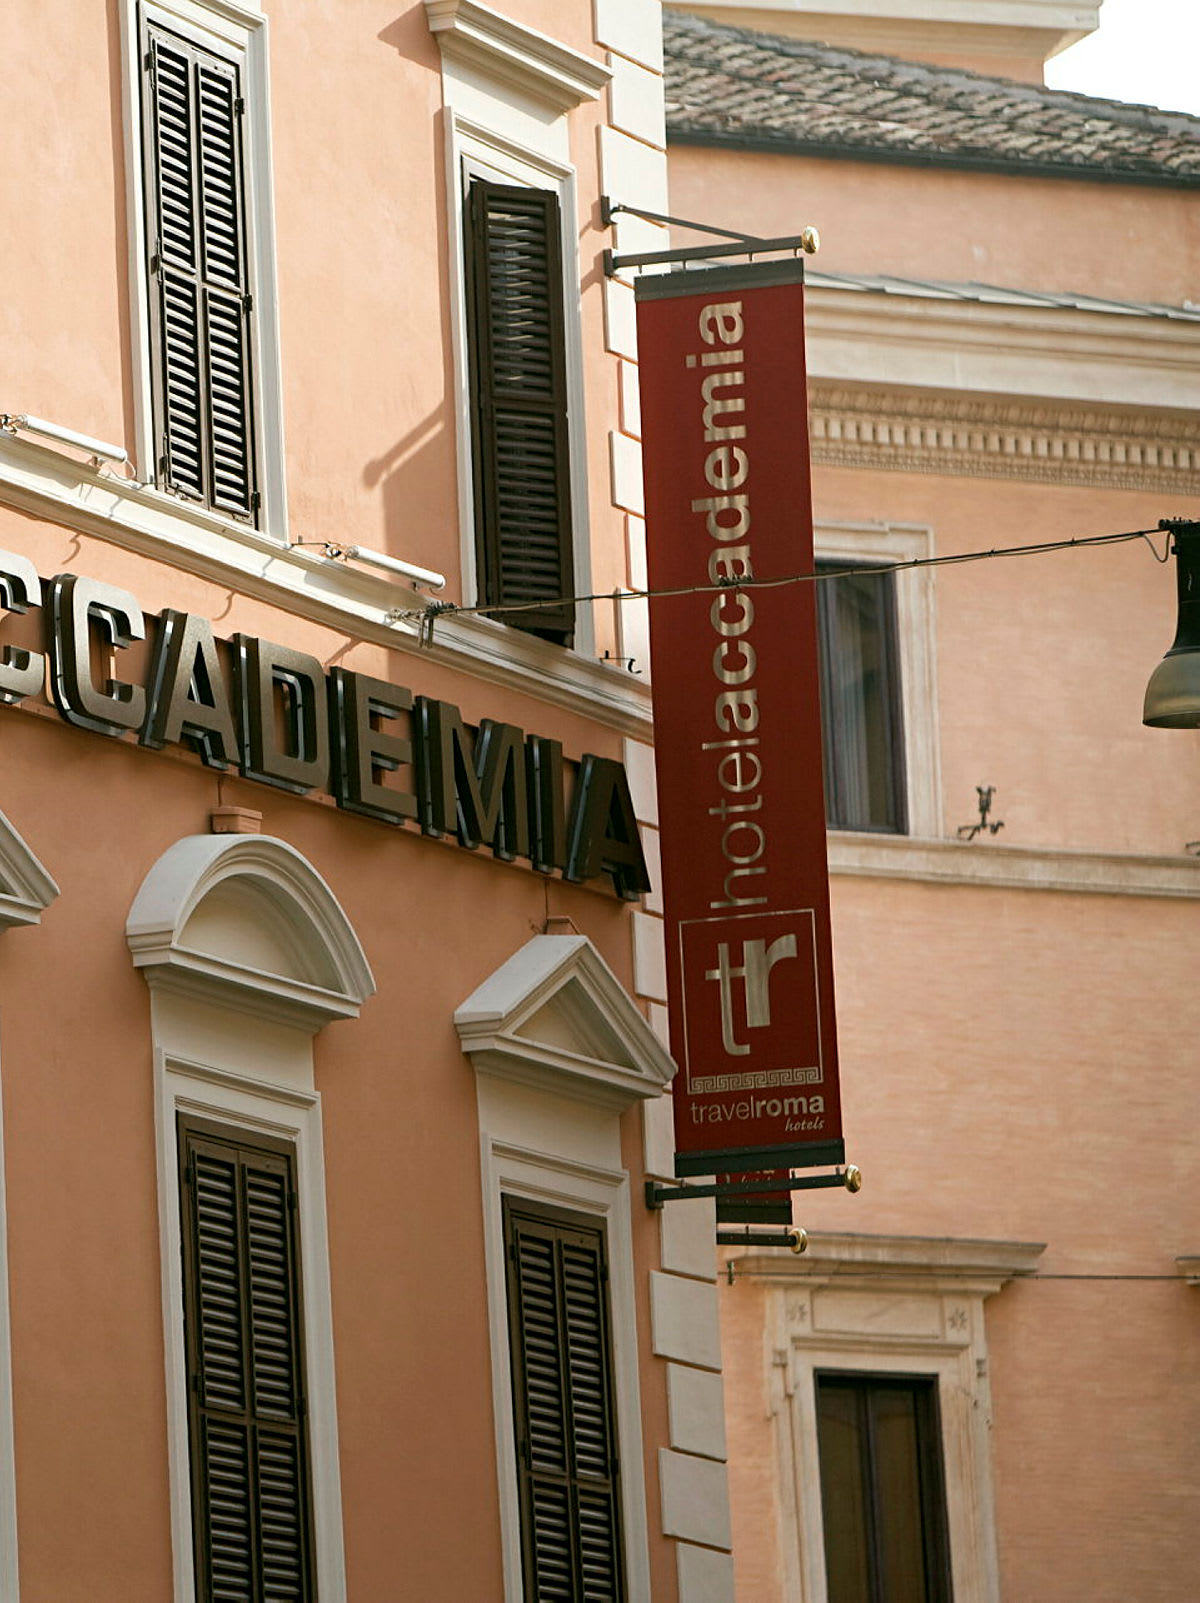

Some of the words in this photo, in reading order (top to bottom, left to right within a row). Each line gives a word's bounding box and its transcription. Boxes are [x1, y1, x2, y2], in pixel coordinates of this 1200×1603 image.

[705, 934, 798, 1056] tr
[690, 1095, 825, 1124] travelroma
[785, 1117, 825, 1132] hotels
